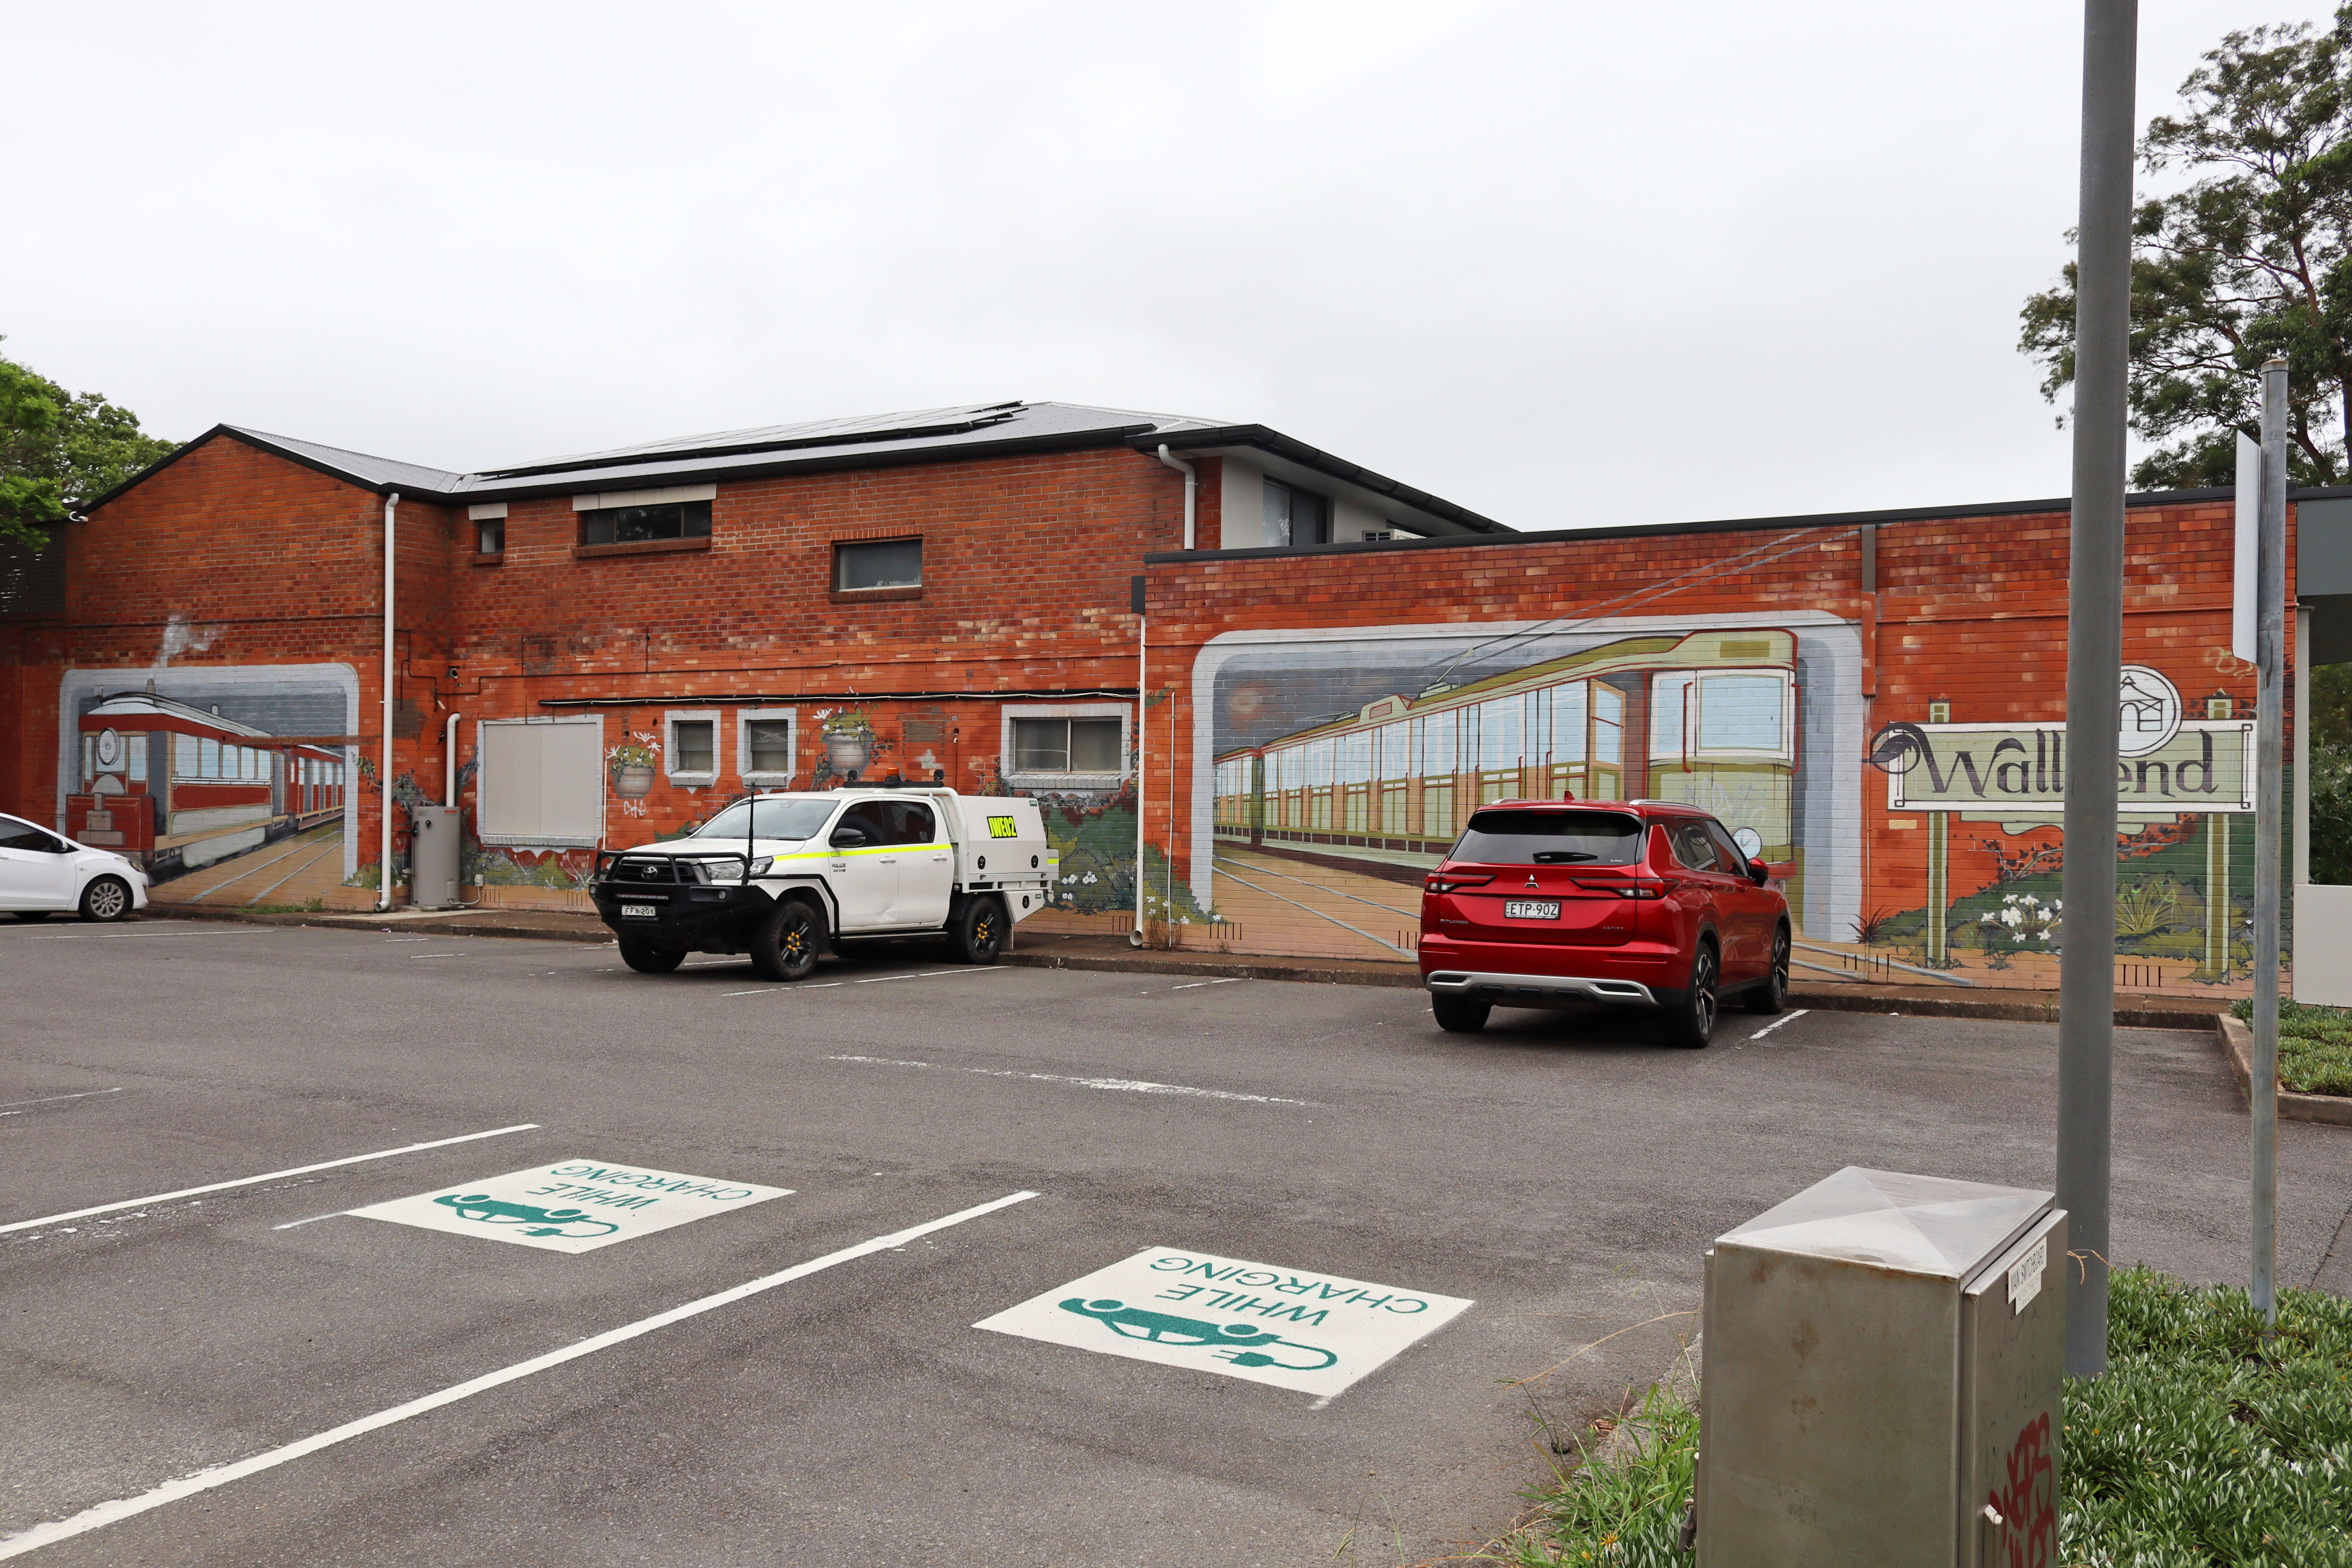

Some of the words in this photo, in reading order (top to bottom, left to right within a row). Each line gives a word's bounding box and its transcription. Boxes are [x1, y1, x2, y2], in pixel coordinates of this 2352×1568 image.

[1871, 723, 2219, 798] Wallend
[988, 817, 1017, 837] JWE02
[524, 1183, 661, 1209] WHILE
[551, 1166, 752, 1200] CHARGING
[1149, 1257, 1429, 1314] CHARGING
[2011, 1268, 2020, 1294] MAIN
[2021, 1245, 2044, 1284] SWITCHBOARD
[1154, 1283, 1329, 1326] WHILE
